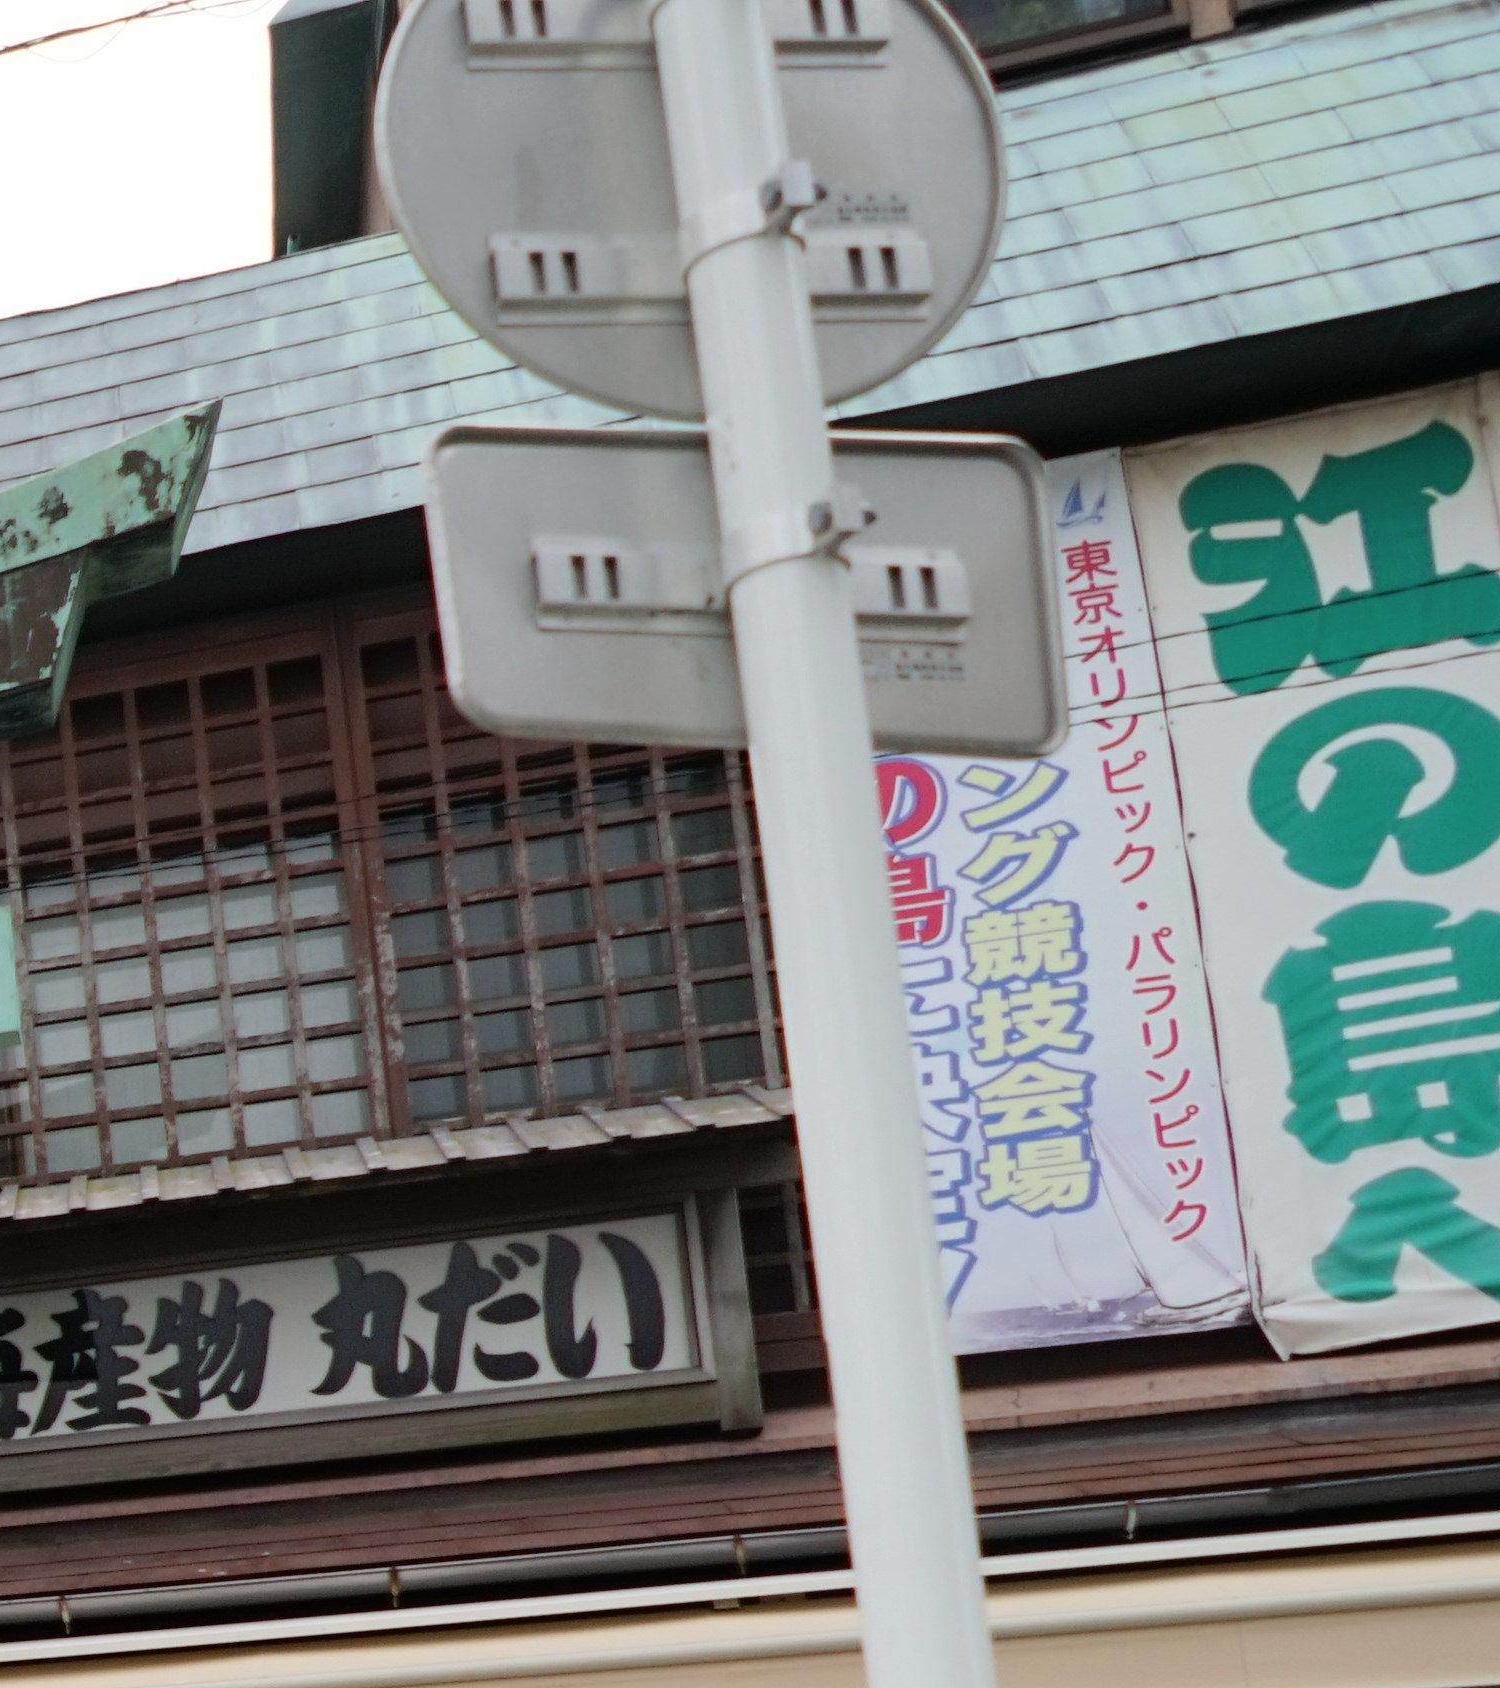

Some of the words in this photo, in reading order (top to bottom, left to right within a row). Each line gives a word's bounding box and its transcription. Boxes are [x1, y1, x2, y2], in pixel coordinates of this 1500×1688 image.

[1061, 539, 1207, 1241] 東京オリンピック・パラリンピック
[311, 1230, 667, 1399] 丸だい
